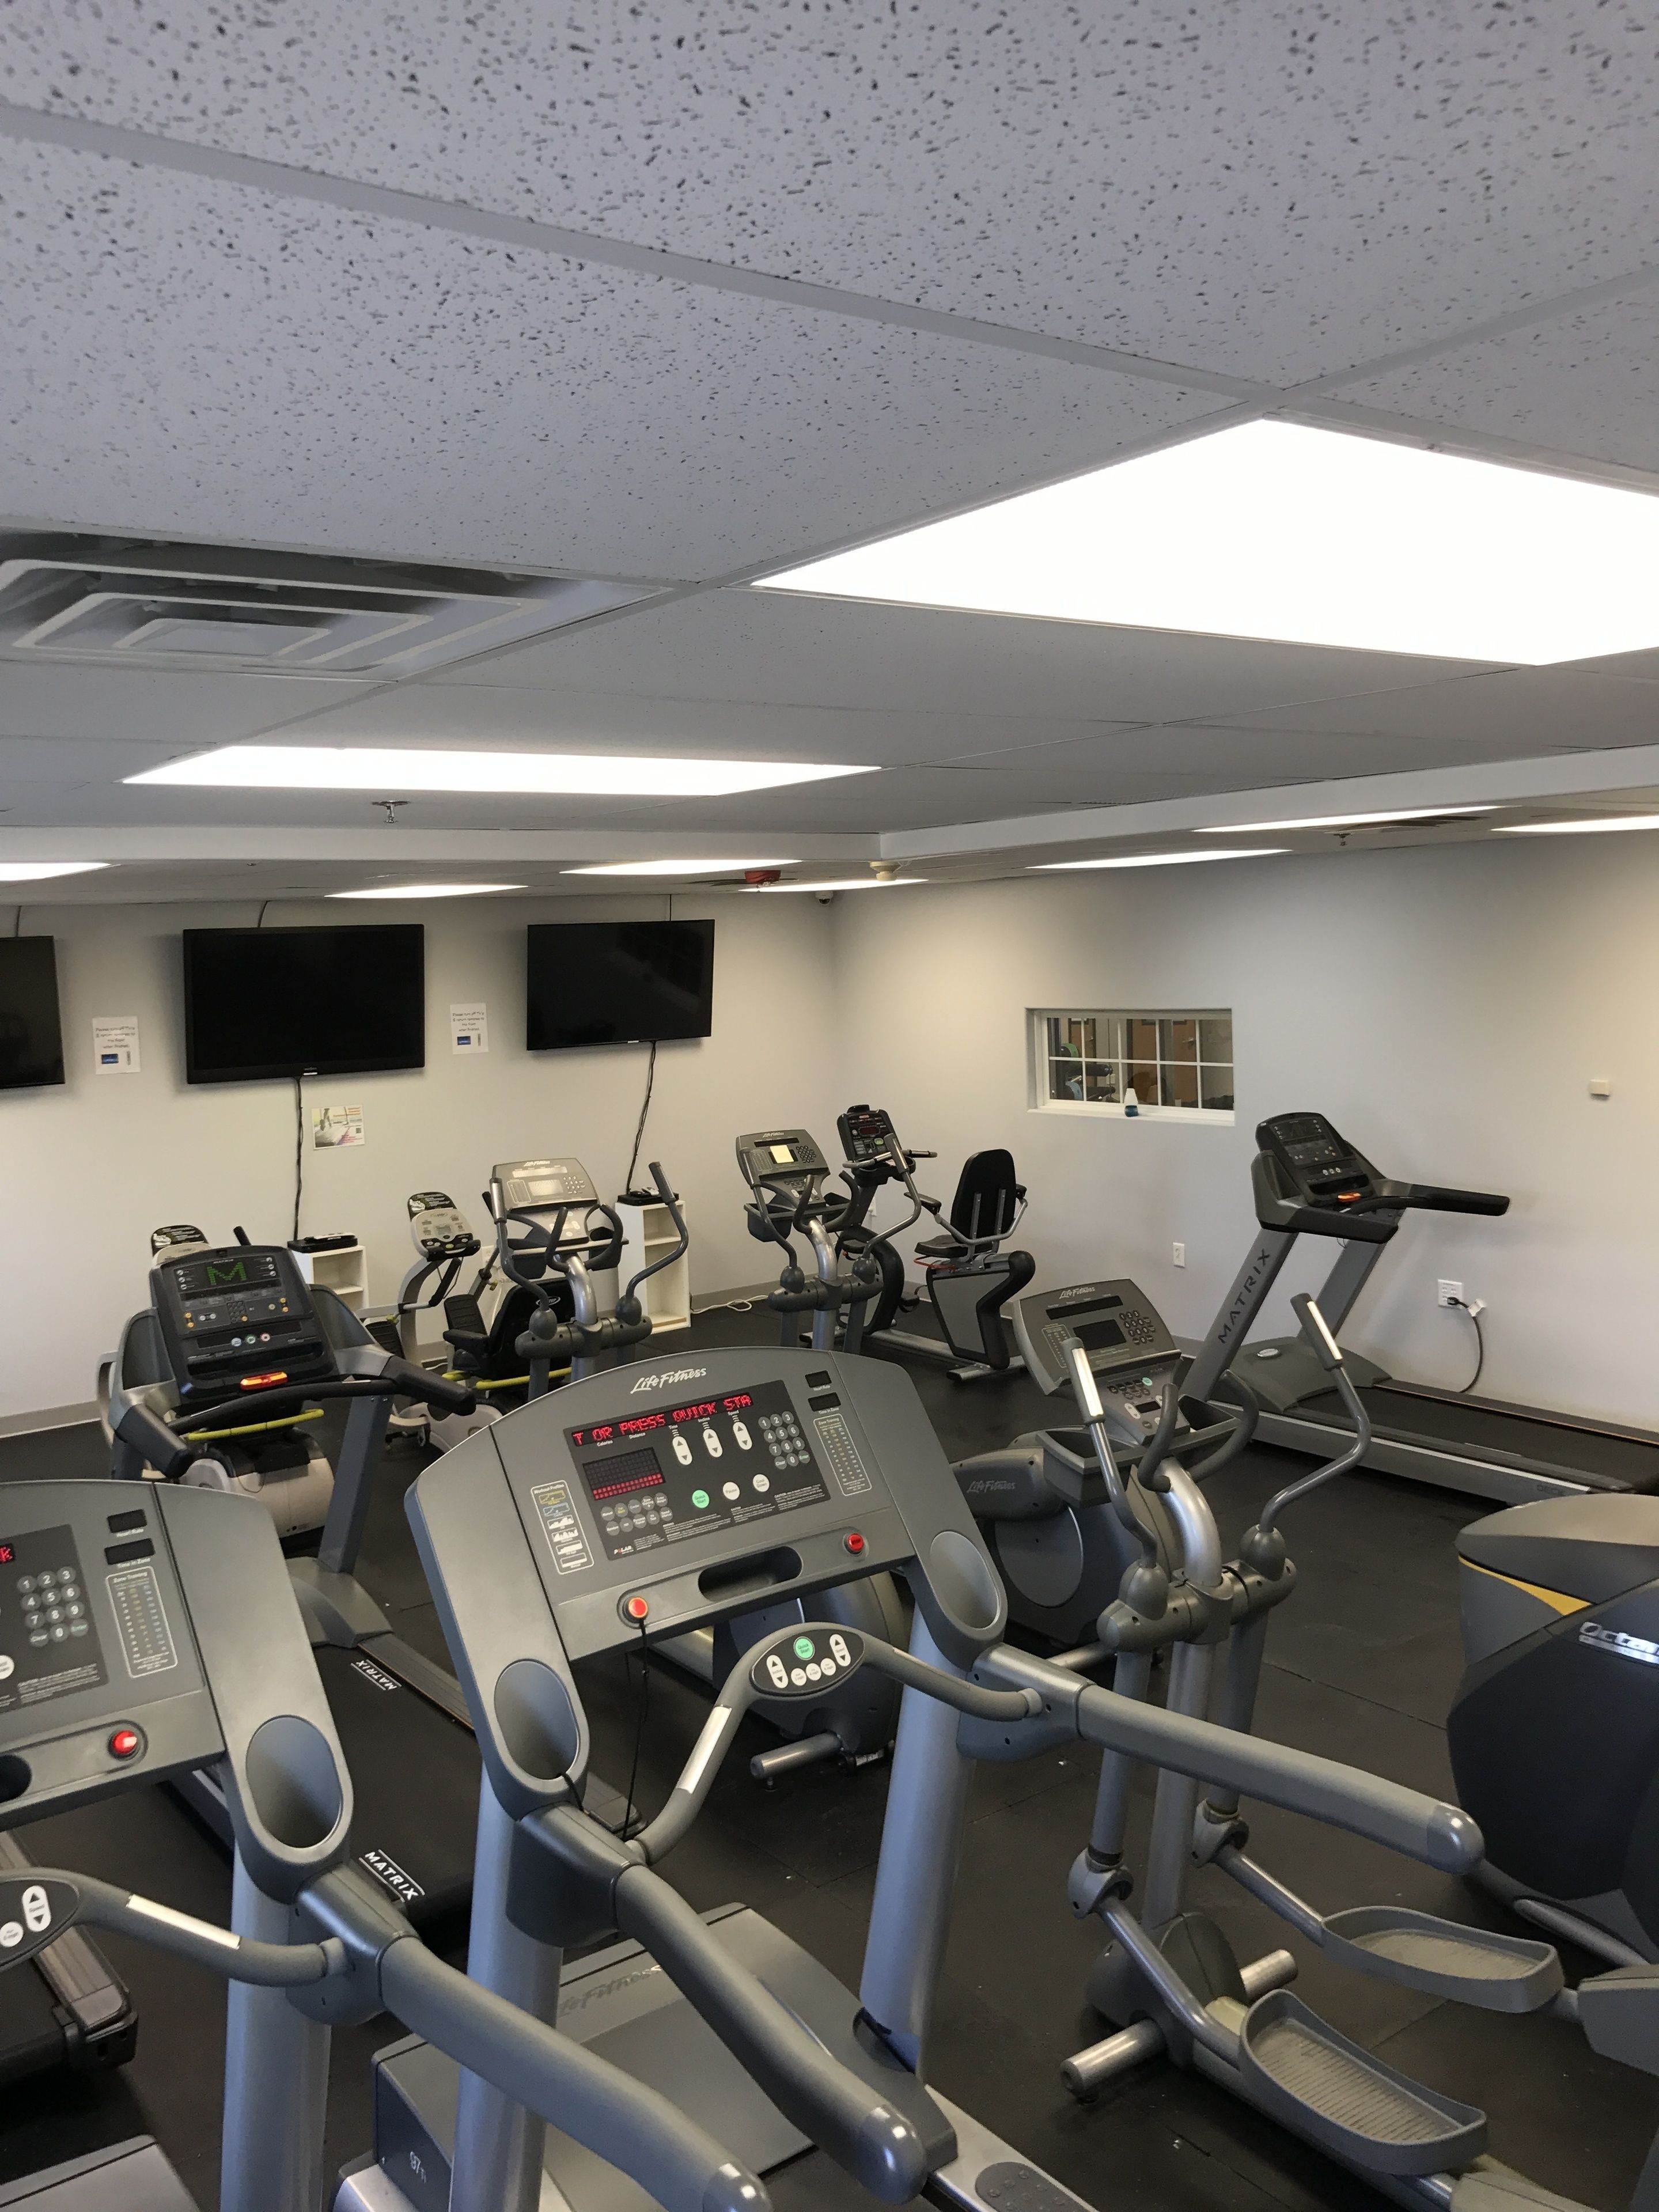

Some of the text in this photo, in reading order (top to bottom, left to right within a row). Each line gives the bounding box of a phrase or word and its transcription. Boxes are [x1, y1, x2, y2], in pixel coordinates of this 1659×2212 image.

[1218, 1248, 1271, 1344] MATRIX
[592, 1426, 613, 1441] OR
[619, 1414, 666, 1435] PRESS
[672, 1402, 718, 1422] QUICK
[723, 1395, 752, 1411] STA
[24, 1570, 70, 1589] 1 2 3
[28, 1588, 75, 1606] 4 5 6
[31, 1605, 79, 1624] 7 8 9
[56, 1628, 64, 1637] 0
[356, 1660, 397, 1690] MATRIX
[365, 1851, 419, 1901] MATRIX
